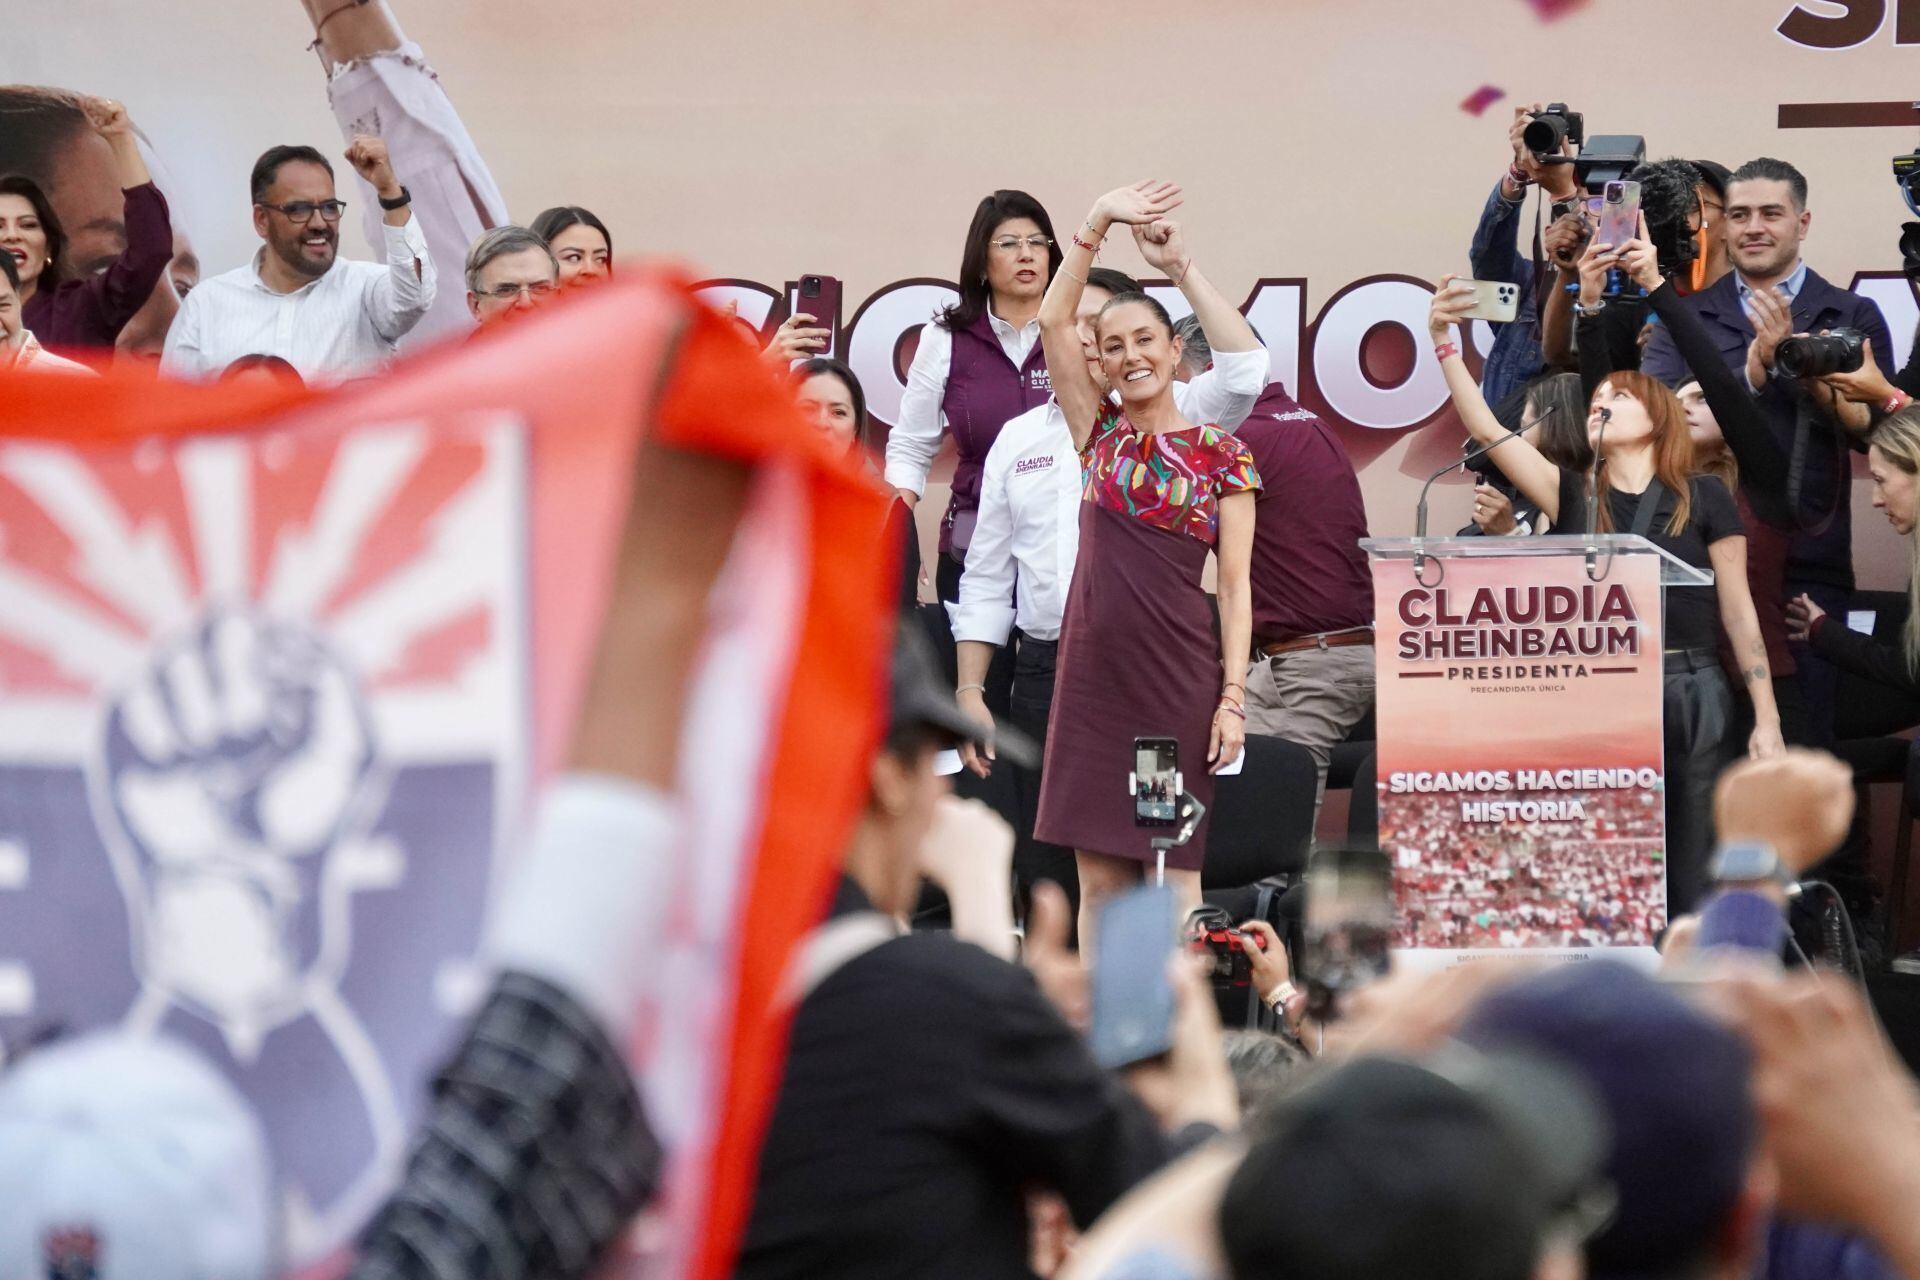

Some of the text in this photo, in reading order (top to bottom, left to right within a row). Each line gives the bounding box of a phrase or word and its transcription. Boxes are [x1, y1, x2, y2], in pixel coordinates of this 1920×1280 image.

[1017, 455, 1054, 468] CLAUDIA
[1398, 583, 1639, 627] CLAUDIA
[1398, 626, 1640, 660] SHEINBAUM
[1447, 664, 1589, 680] PRESIDENTA
[1470, 683, 1566, 693] PRECANDIDATA ÚNICA
[1389, 768, 1658, 793] SIGAMOS HACIENDO
[1462, 800, 1587, 822] HISTORIA
